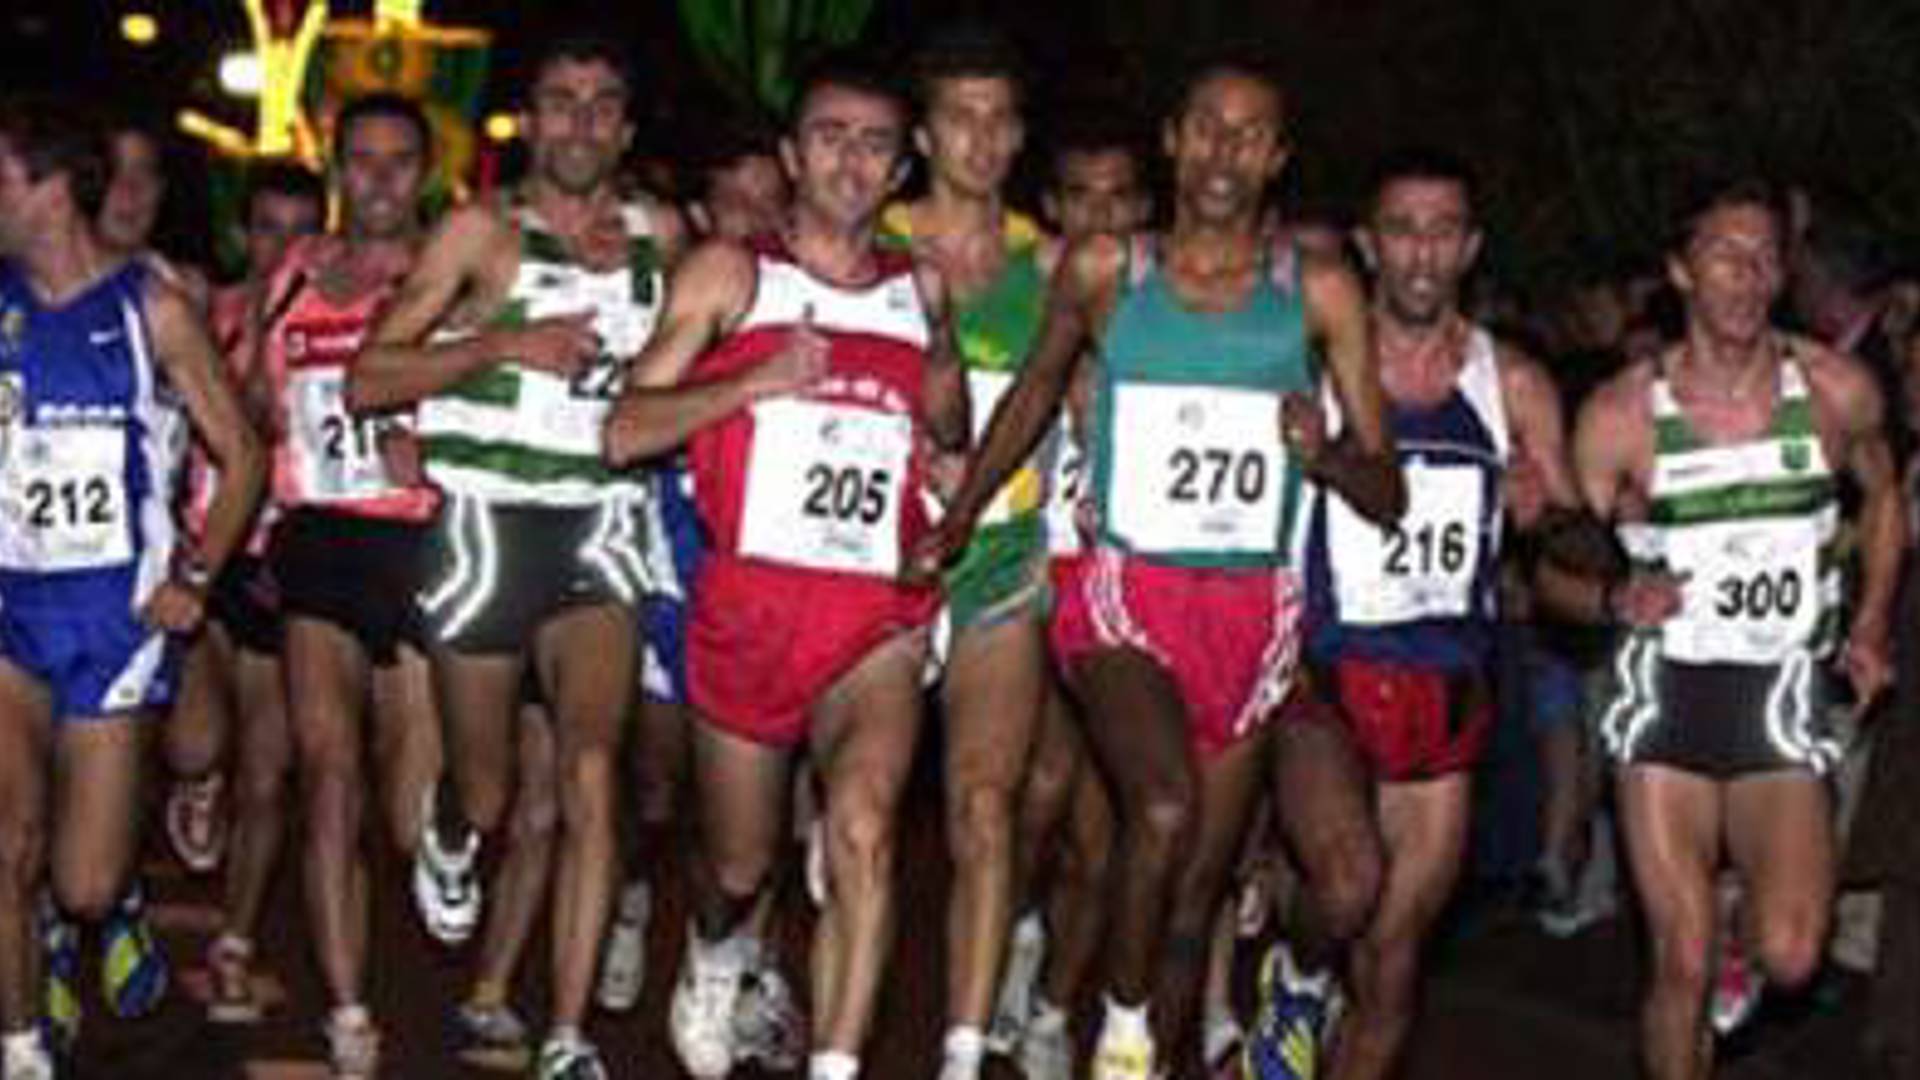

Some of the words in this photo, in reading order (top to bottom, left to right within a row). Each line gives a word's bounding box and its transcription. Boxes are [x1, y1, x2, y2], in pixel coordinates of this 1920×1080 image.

[26, 475, 117, 528] 212
[802, 463, 890, 524] 205
[1167, 447, 1266, 503] 270
[1382, 521, 1466, 575] 216
[1715, 568, 1802, 619] 300
